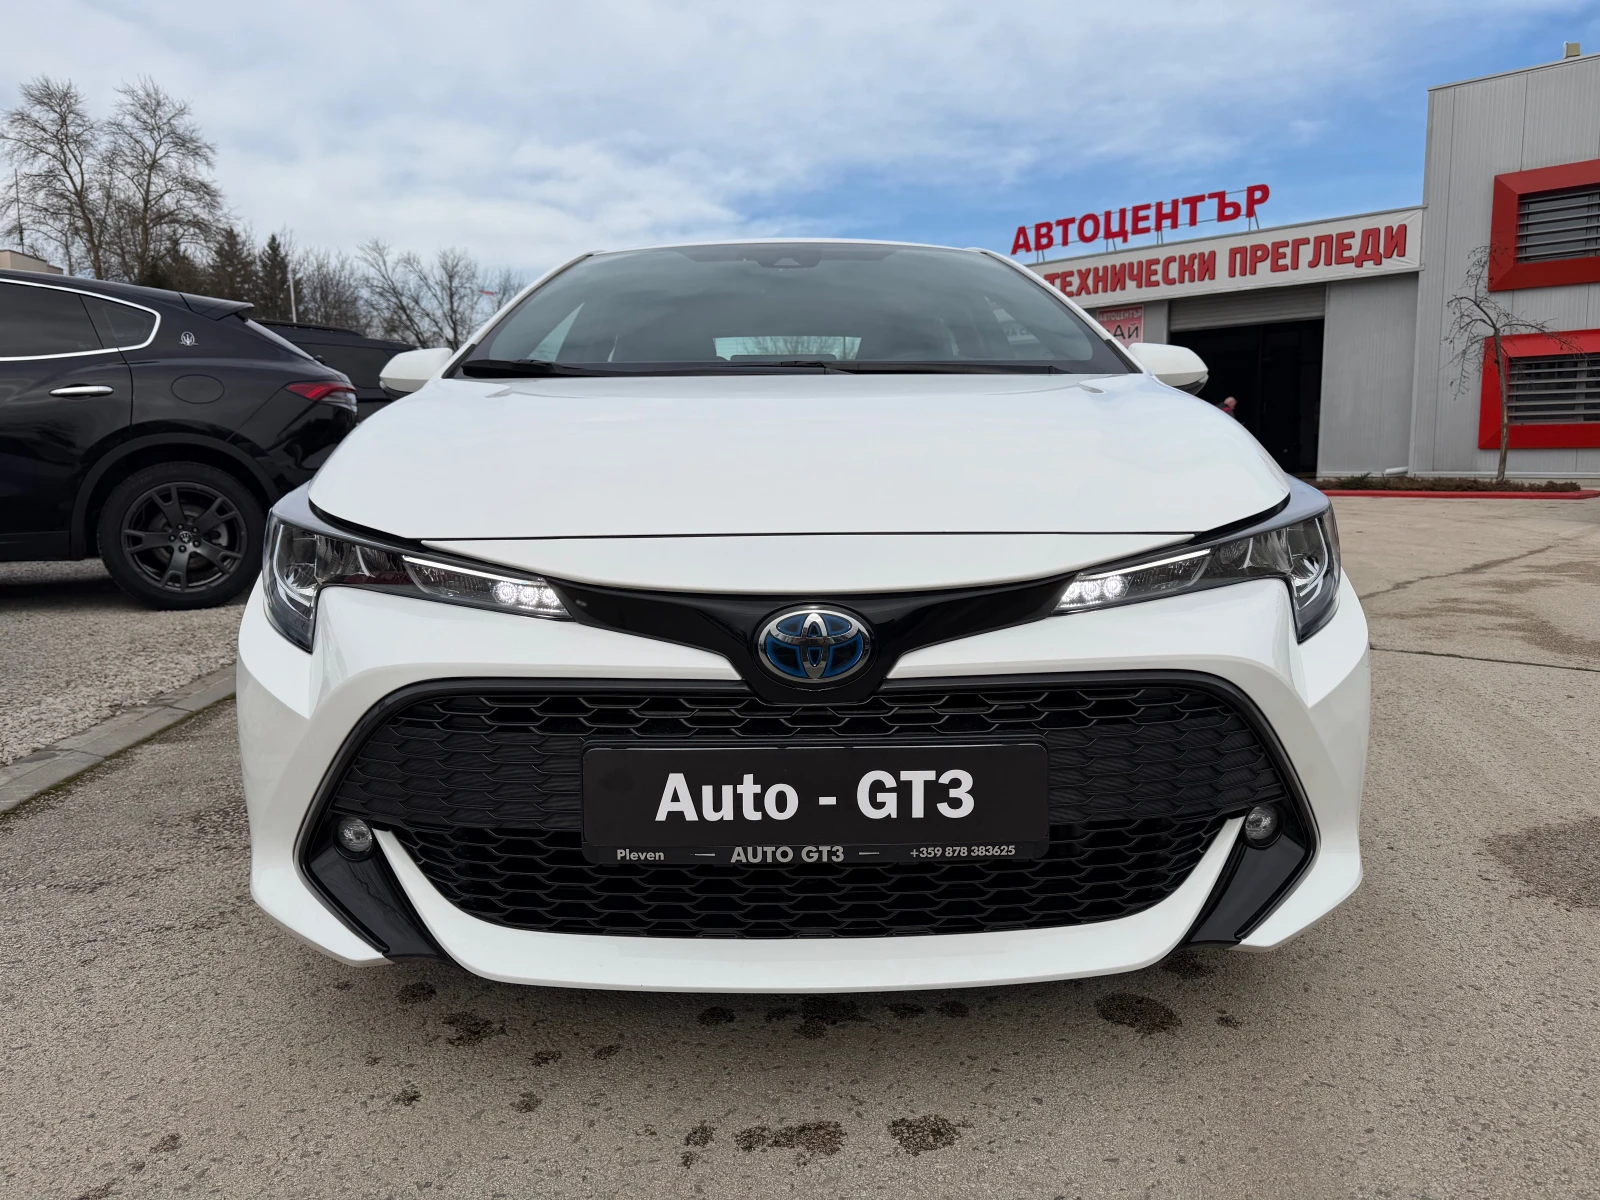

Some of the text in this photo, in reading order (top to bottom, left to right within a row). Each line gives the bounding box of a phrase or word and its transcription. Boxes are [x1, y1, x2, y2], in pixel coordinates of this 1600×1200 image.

[1010, 183, 1270, 256] АВТОЦЕНТЪР
[1228, 223, 1408, 278] ПРЕГЛЕДИ
[1099, 309, 1142, 321] АВТОЦЕНТЪР
[1106, 323, 1139, 340] АЙ
[655, 772, 799, 822] Auto
[856, 769, 975, 820] GT3
[616, 849, 665, 861] Pleven
[730, 846, 844, 863] AUTO GT3
[910, 845, 1016, 858] +359 878 383625
